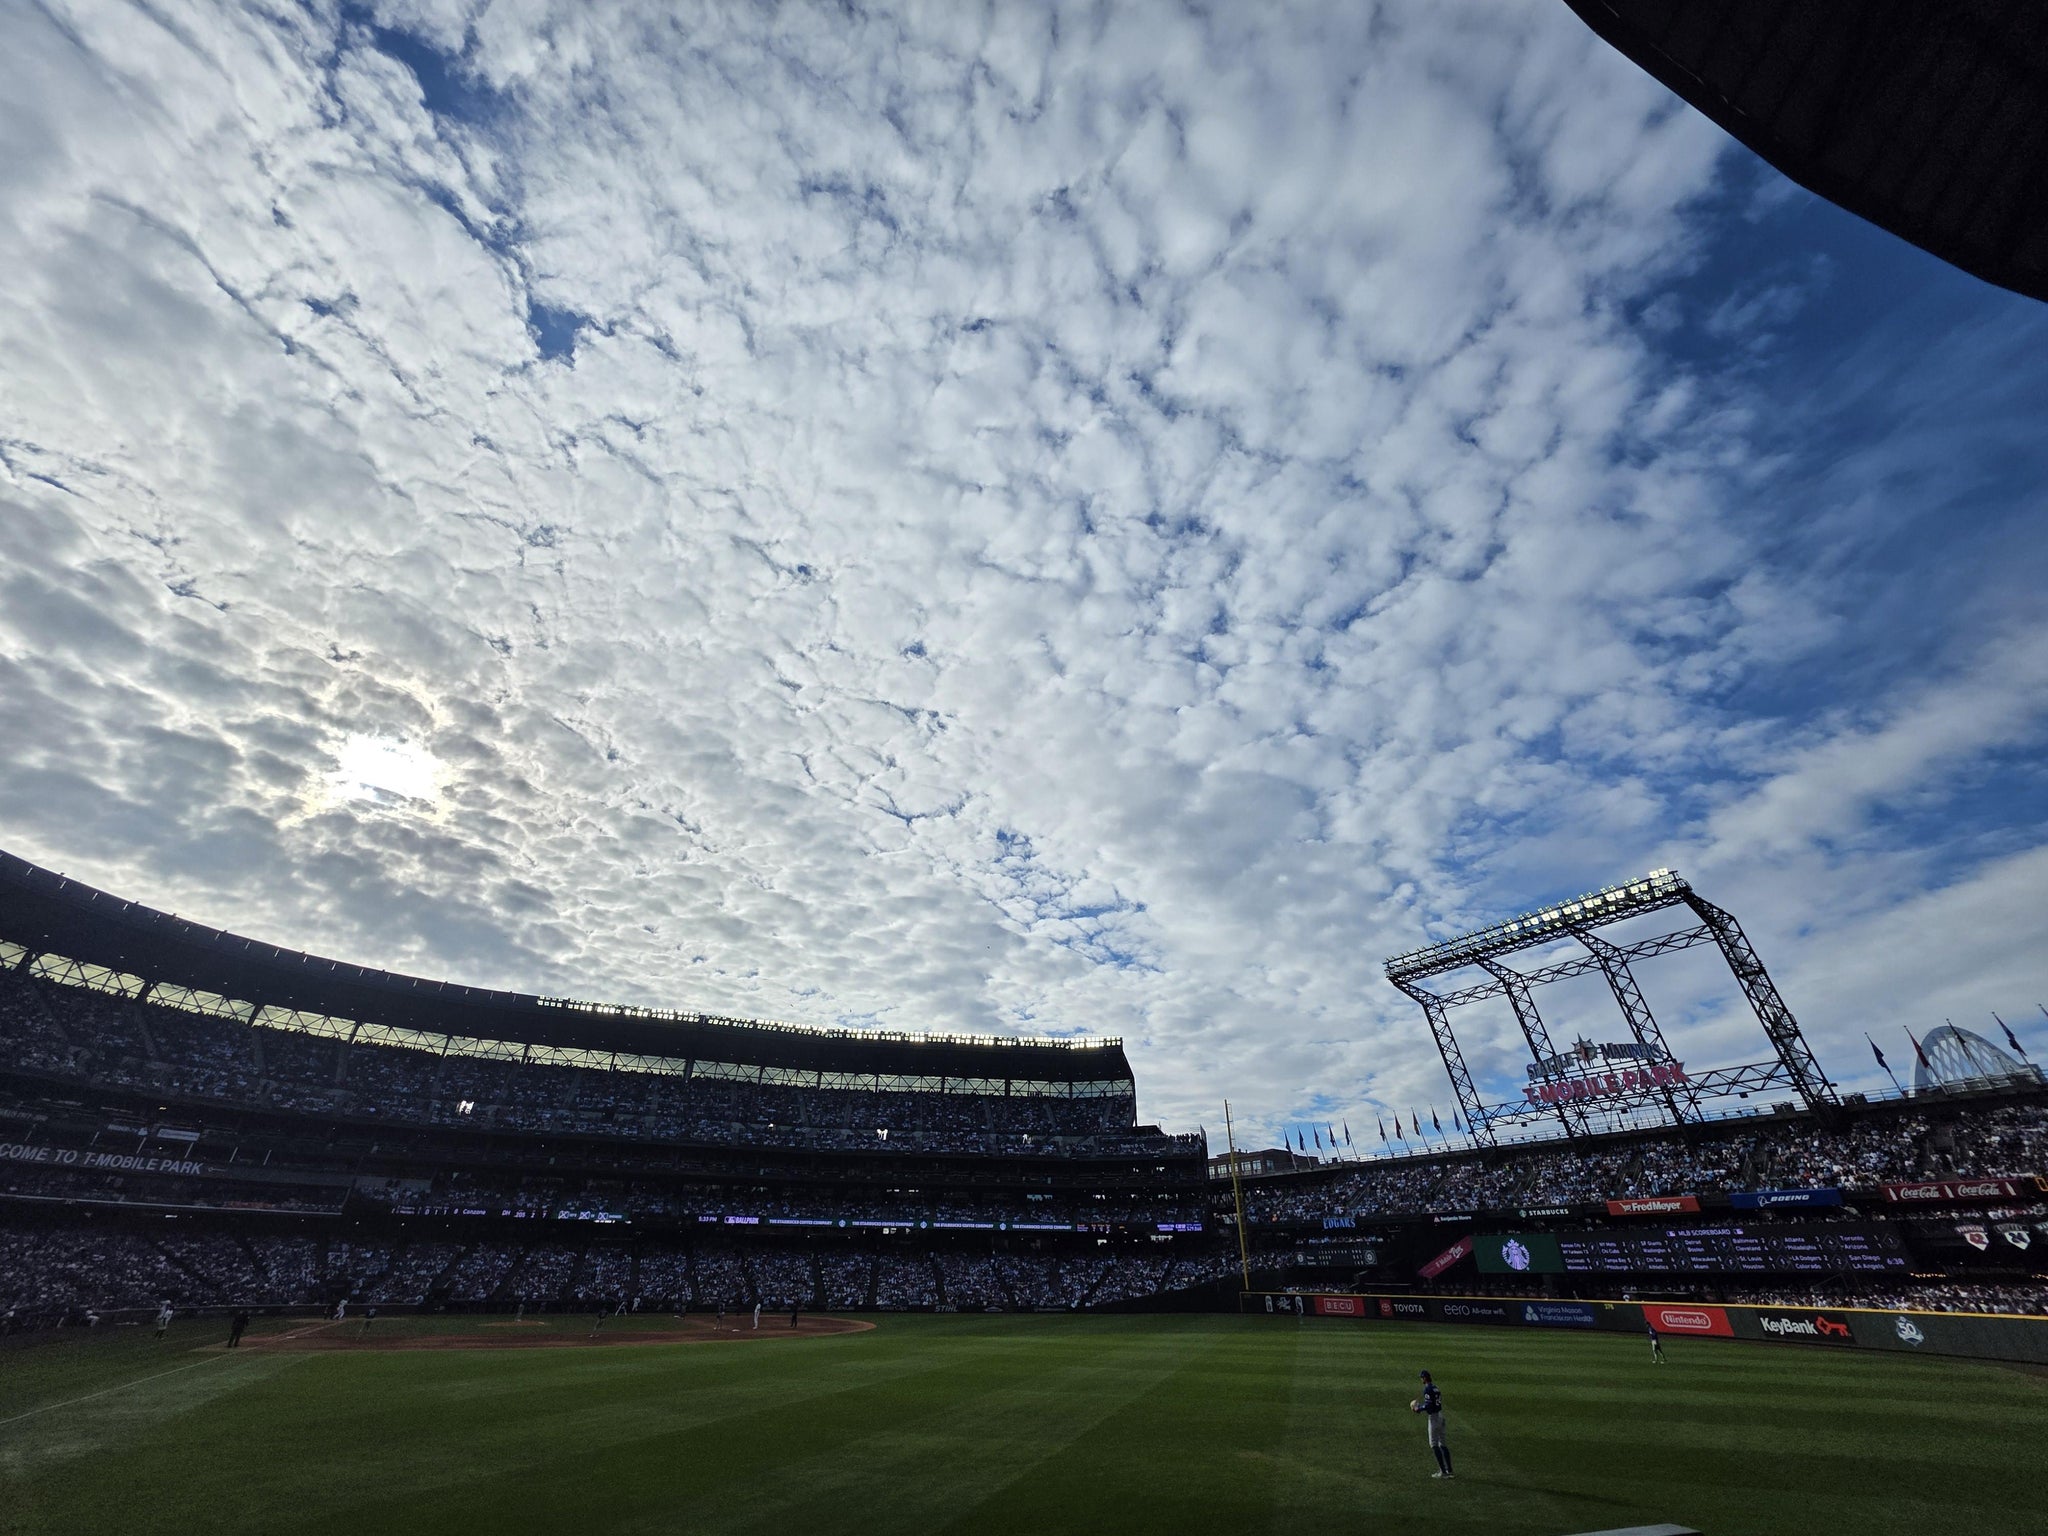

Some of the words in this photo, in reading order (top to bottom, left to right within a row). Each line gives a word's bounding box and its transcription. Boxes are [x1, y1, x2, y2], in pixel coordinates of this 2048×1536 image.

[1522, 1072, 1621, 1104] T-MOBILE
[1622, 1062, 1691, 1091] PARK
[53, 1149, 78, 1164] TO
[83, 1152, 159, 1171] T-MOBILE
[160, 1160, 205, 1175] PARK
[1900, 1185, 1943, 1199] Coca-Cola
[1957, 1182, 2003, 1197] Coca-Cola
[1770, 1194, 1811, 1203] BOEING
[1529, 1208, 1570, 1217] STARBUCKS
[935, 1304, 959, 1313] STIHL
[1326, 1300, 1353, 1312] BECU
[1393, 1302, 1424, 1314] TOYOTA
[1444, 1304, 1471, 1316] eero
[1539, 1306, 1561, 1316] Virginia
[1562, 1306, 1583, 1315] Mason
[1540, 1314, 1573, 1323] Franciscan
[1574, 1315, 1594, 1323] Health
[1664, 1314, 1707, 1327] Nintendo
[1761, 1316, 1819, 1337] KeyBank
